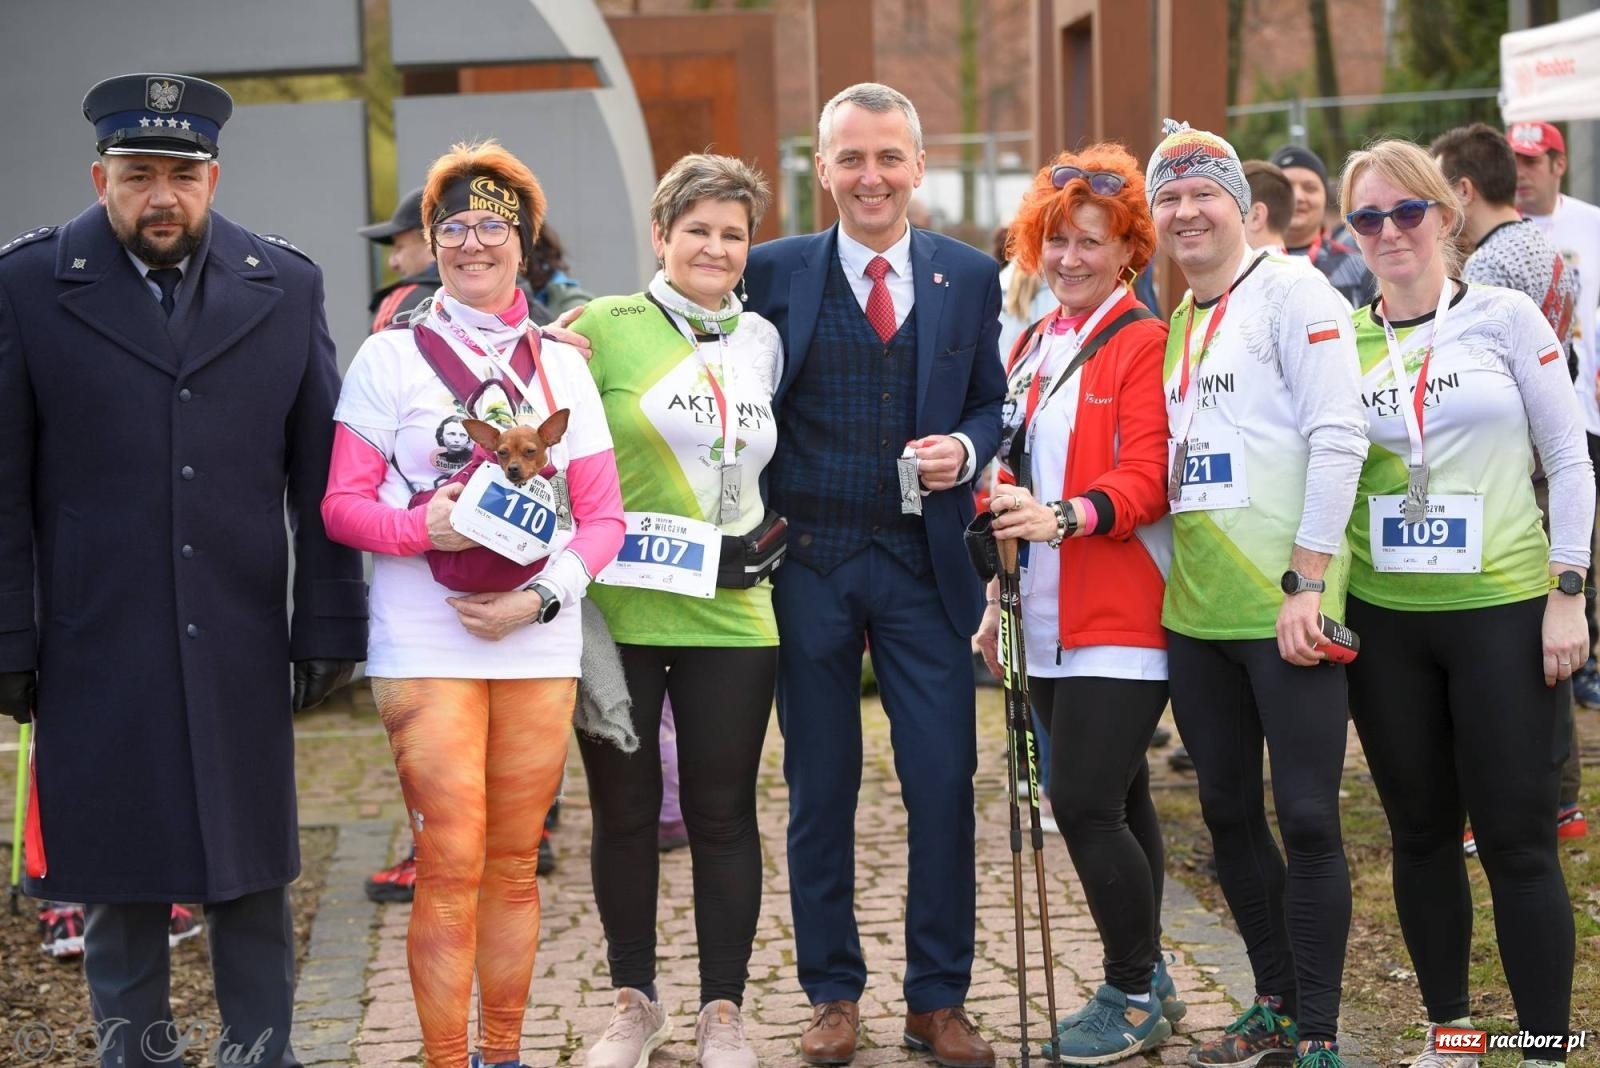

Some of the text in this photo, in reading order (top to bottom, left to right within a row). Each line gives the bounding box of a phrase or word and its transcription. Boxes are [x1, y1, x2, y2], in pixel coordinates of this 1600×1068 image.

[611, 305, 646, 317] deep
[667, 393, 772, 421] AKTWNI
[1377, 394, 1440, 417] LYKI
[695, 412, 760, 430] LYKI
[502, 493, 548, 535] 110
[1425, 505, 1446, 514] CZYM
[1397, 519, 1449, 545] 109
[637, 535, 689, 565] 107
